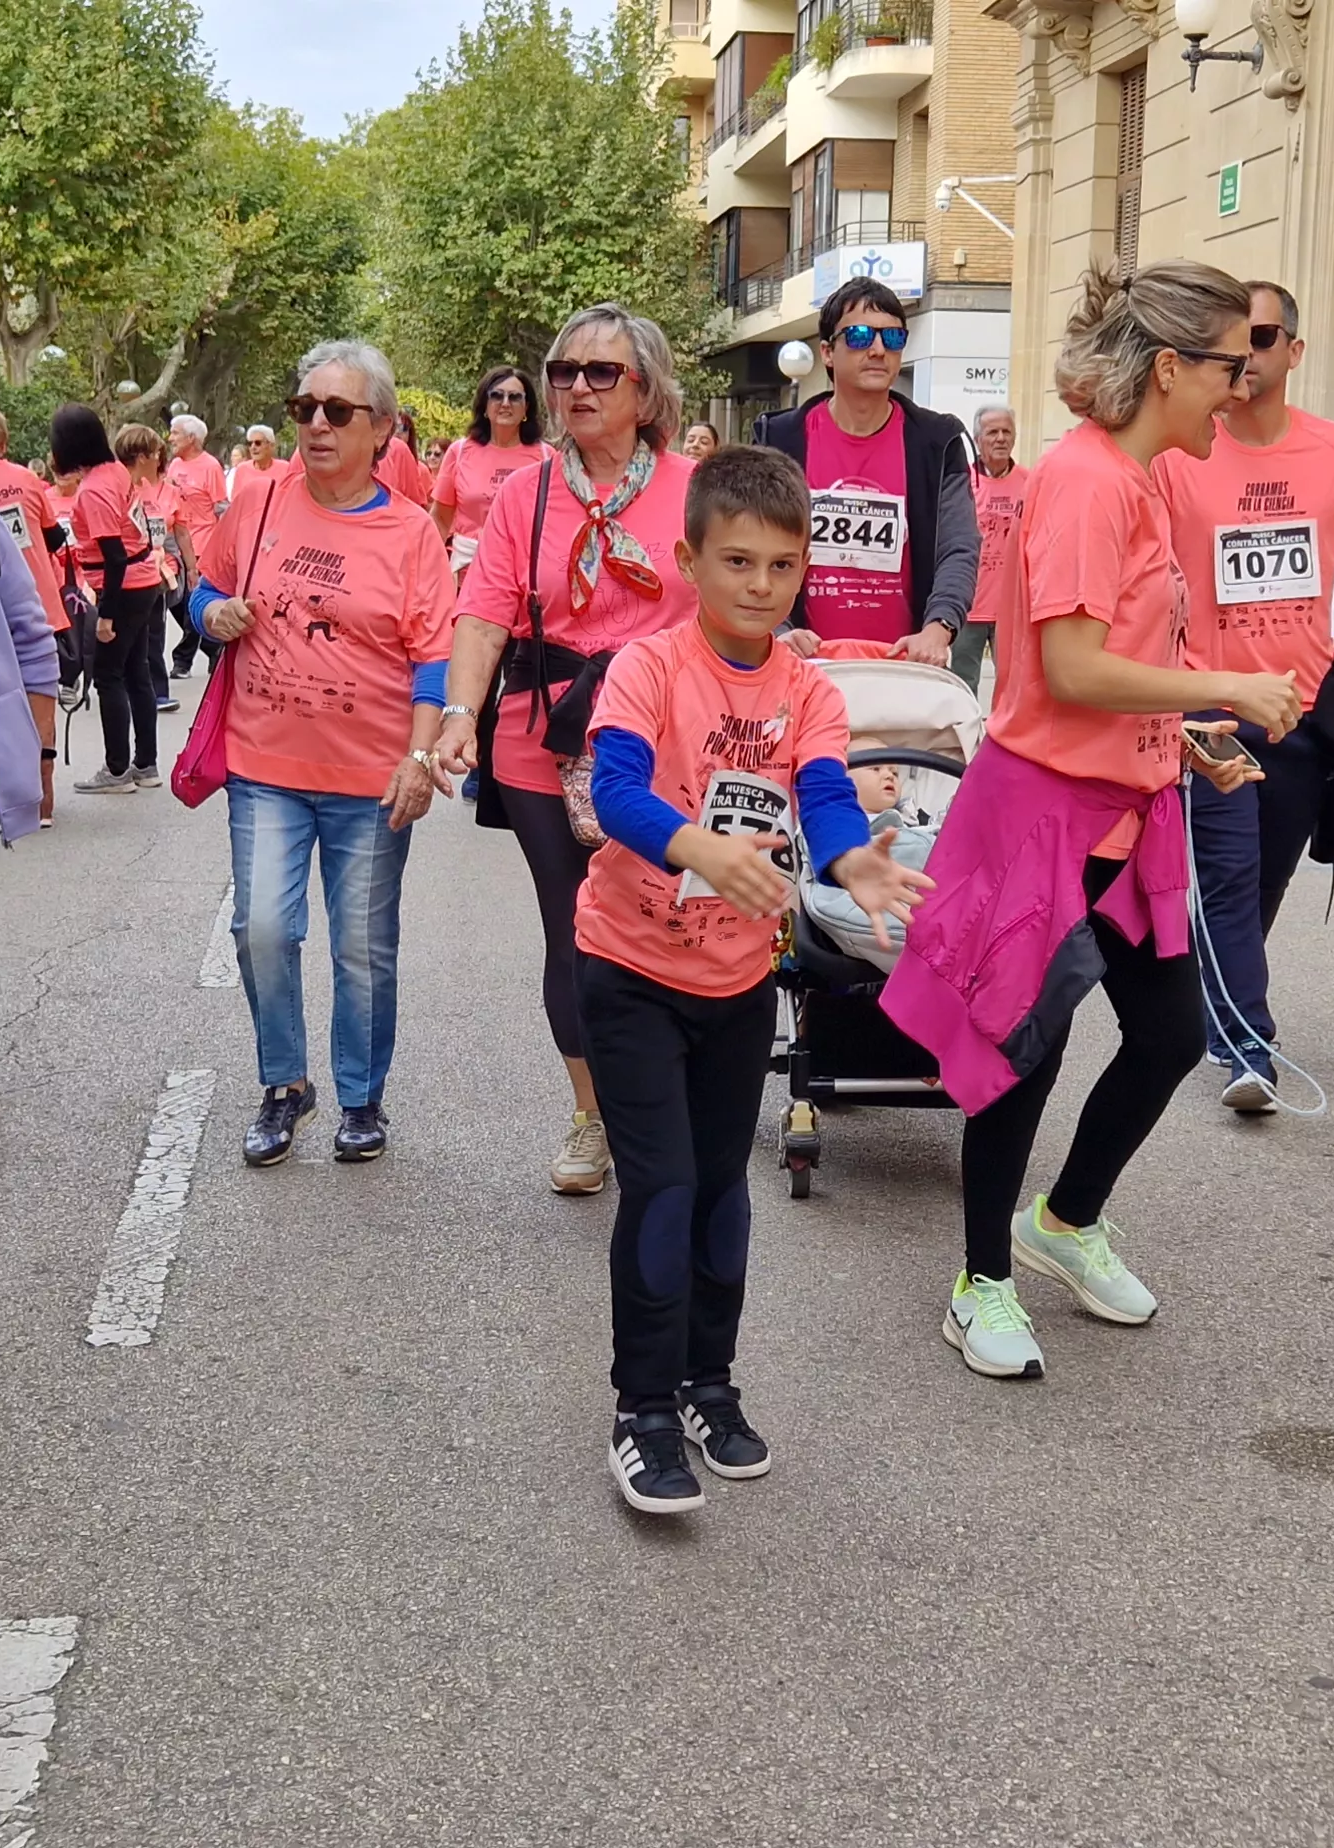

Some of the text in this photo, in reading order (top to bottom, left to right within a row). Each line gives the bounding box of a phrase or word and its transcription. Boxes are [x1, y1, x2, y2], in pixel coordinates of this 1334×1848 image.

[965, 367, 1009, 381] SMY S
[1245, 481, 1289, 497] CORRAMOS
[814, 503, 895, 516] CONTRA EL CÁNCER
[1237, 495, 1295, 512] POR LA CIENCIA
[811, 515, 895, 549] 2844
[1226, 539, 1259, 548] CONTRA
[1271, 535, 1306, 545] CÁNCER
[295, 546, 346, 570] CORRAMOS
[1227, 547, 1308, 580] 1070
[278, 558, 346, 585] POR LA CIENCIA
[726, 784, 765, 799] HUESCA
[735, 796, 751, 808] EL
